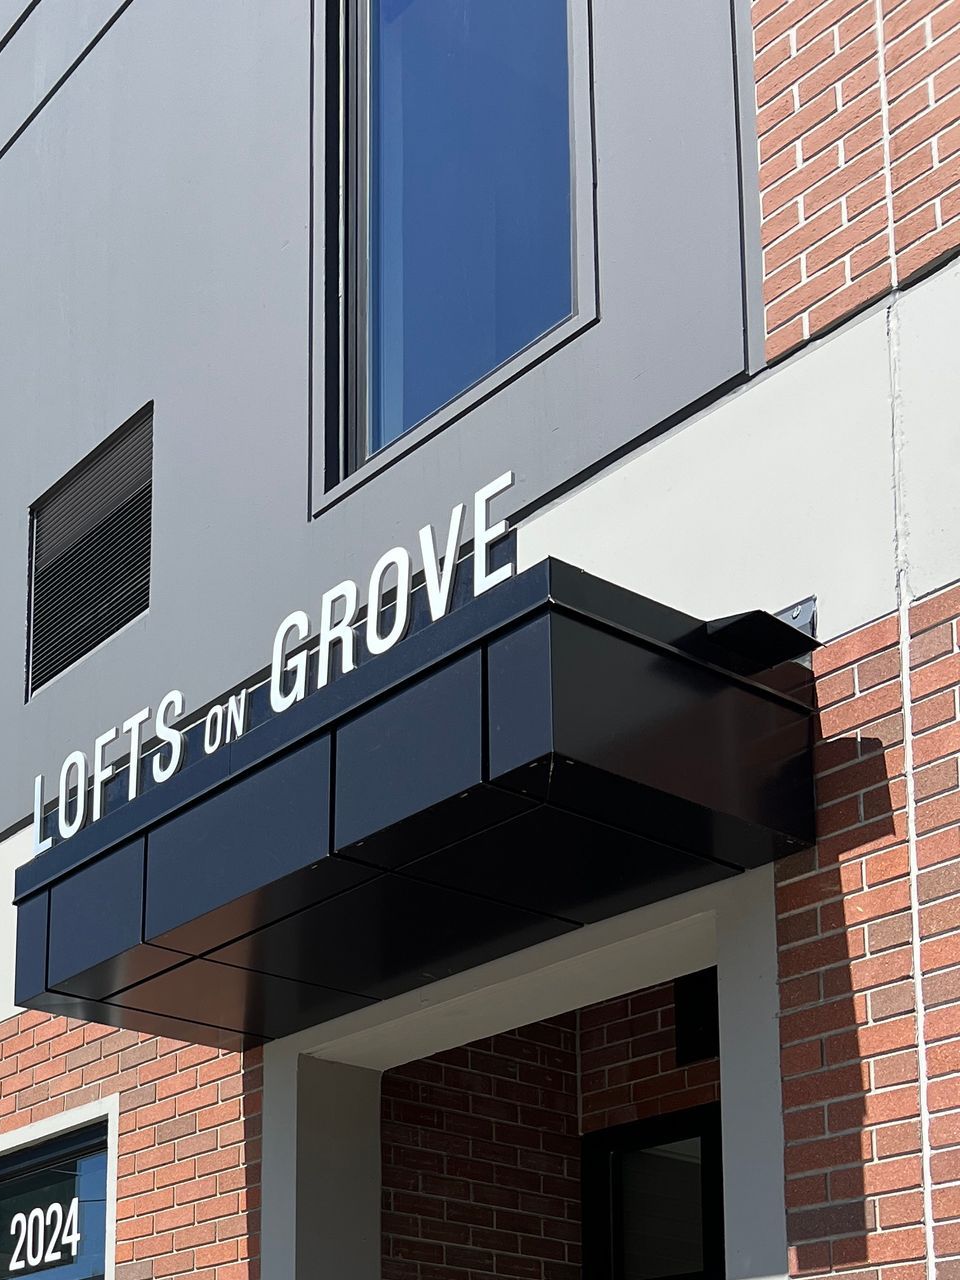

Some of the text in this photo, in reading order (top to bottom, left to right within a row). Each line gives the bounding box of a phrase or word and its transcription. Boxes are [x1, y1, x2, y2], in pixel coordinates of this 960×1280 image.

[33, 470, 516, 858] LOFTS ON GROVE
[9, 1197, 81, 1271] 2024
